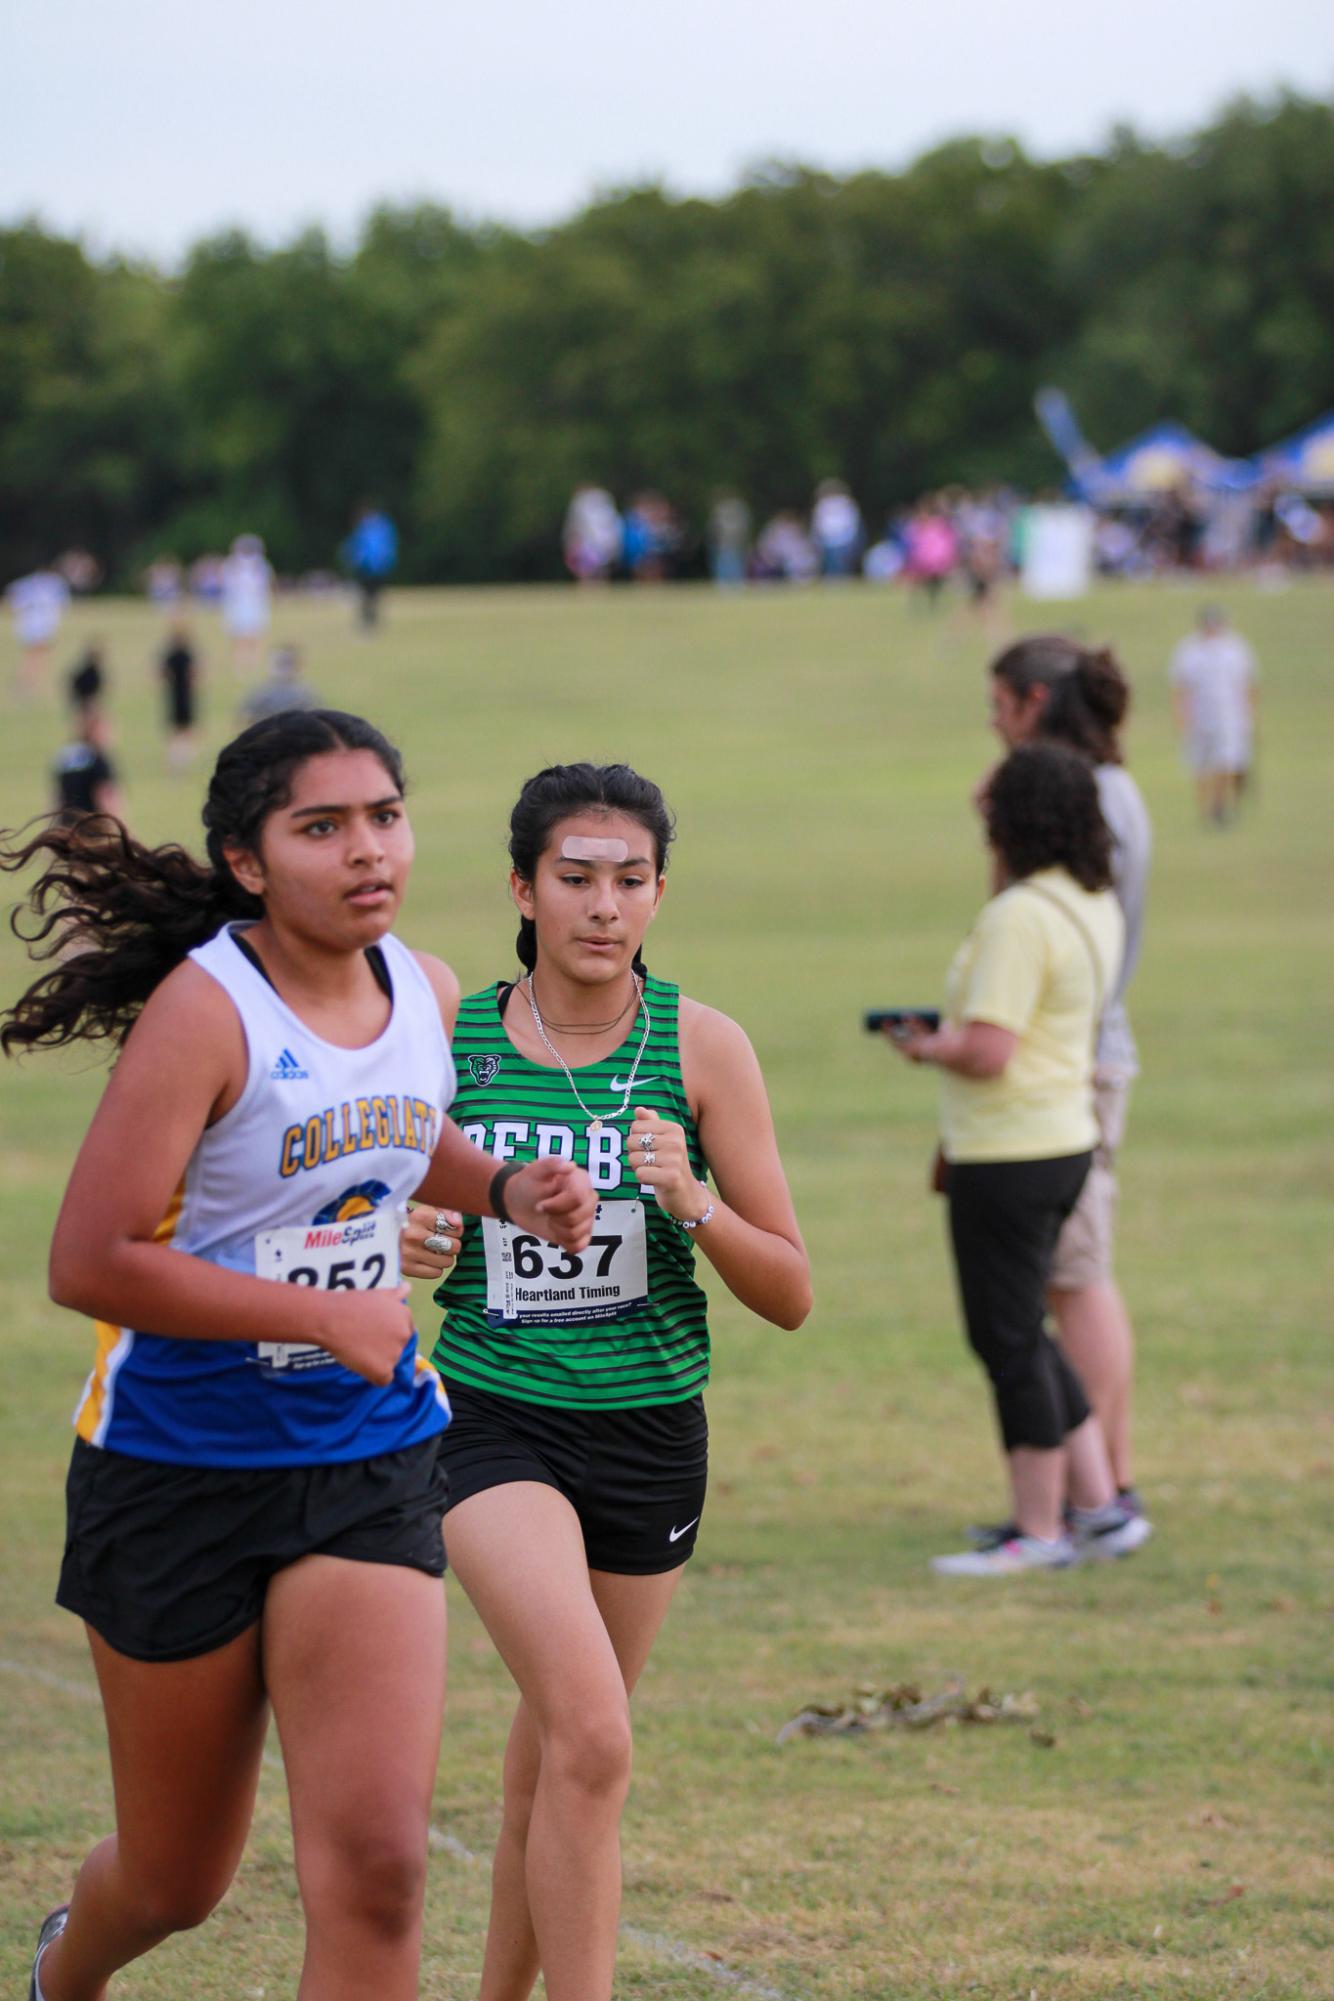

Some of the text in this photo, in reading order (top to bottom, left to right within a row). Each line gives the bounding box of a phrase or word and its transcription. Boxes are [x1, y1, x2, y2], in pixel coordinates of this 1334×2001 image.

[270, 1068, 309, 1080] adidas
[462, 1121, 656, 1195] ERB
[512, 1234, 623, 1280] 637
[515, 1287, 576, 1302] Heartland
[579, 1285, 620, 1301] Timing
